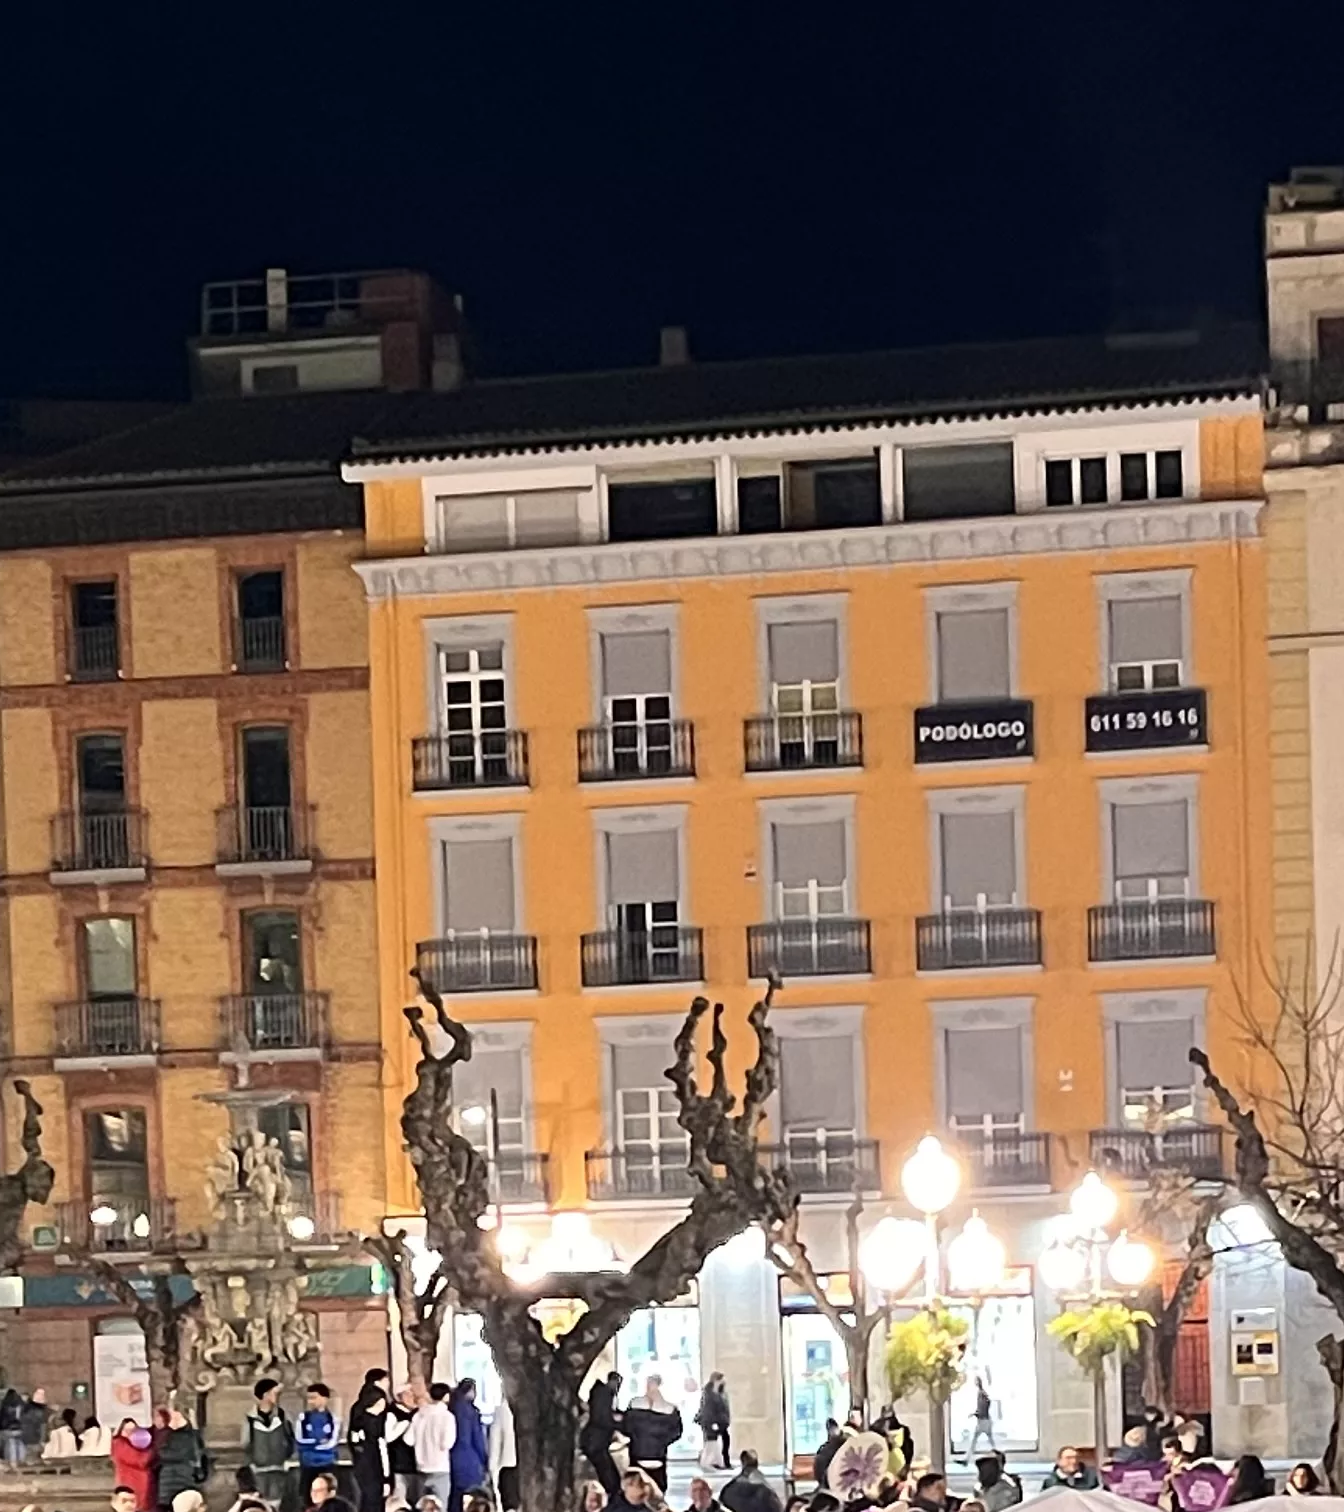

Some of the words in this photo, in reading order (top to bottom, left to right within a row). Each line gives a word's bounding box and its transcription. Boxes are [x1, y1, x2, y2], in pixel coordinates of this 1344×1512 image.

[919, 720, 1025, 742] PODÓLOGO
[1090, 714, 1121, 732] 611
[1126, 713, 1148, 730] 59
[1152, 711, 1173, 728] 16
[1177, 707, 1198, 725] 16
